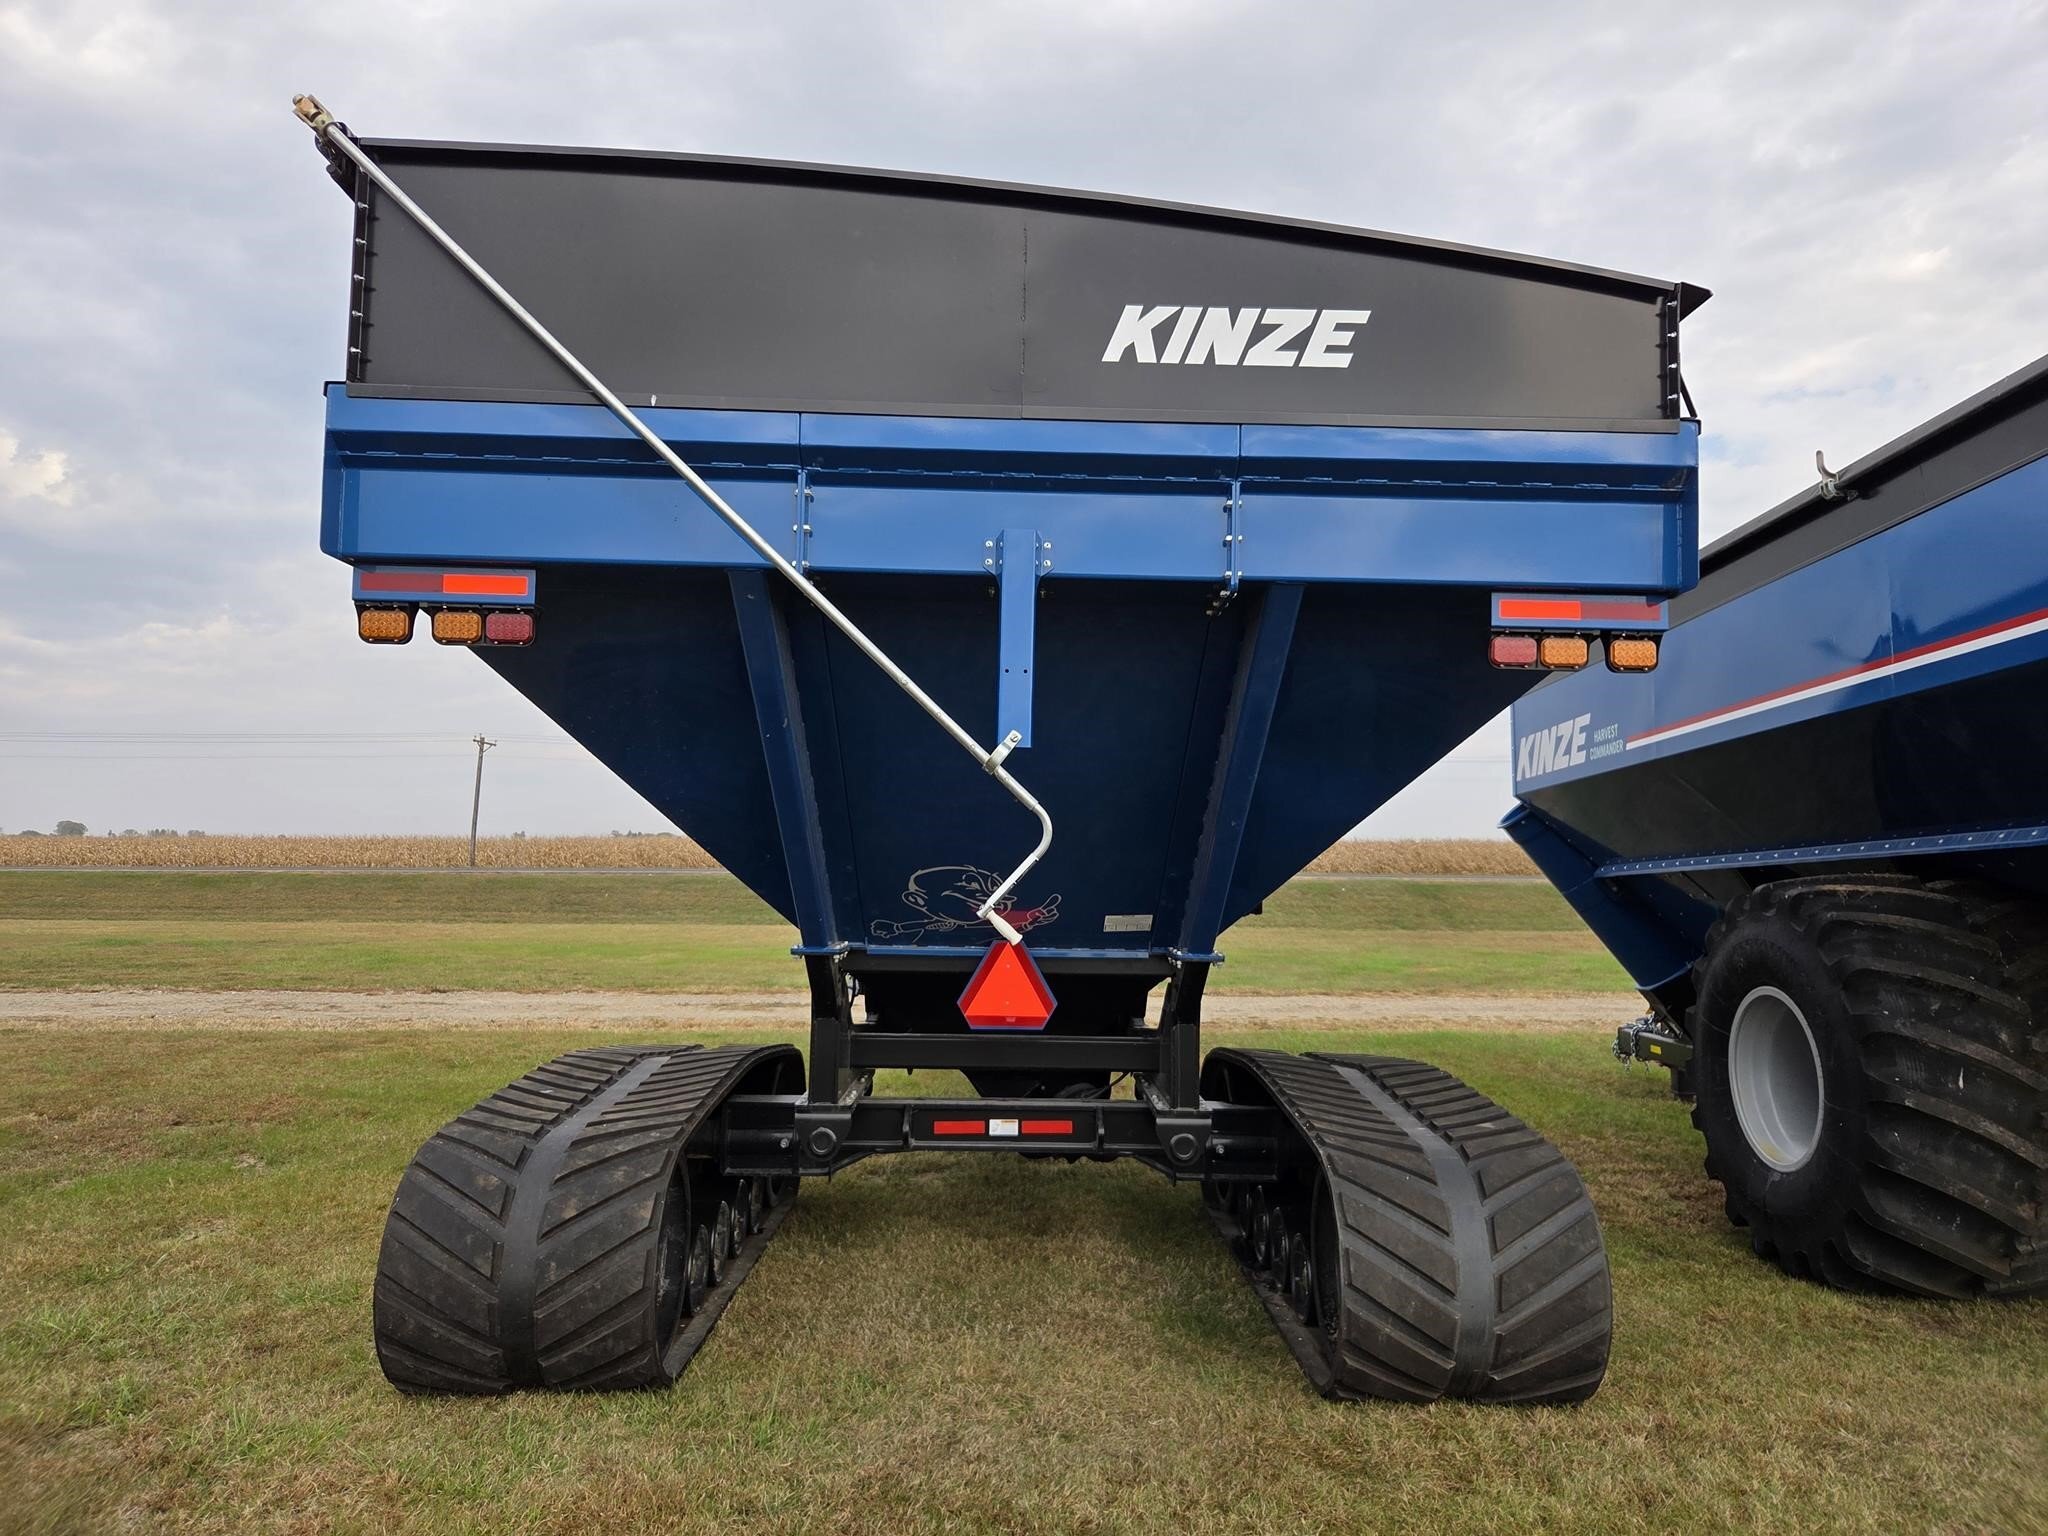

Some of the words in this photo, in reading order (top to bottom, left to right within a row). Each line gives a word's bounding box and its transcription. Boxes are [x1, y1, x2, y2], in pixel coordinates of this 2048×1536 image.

[1101, 304, 1372, 368] KINZE
[1516, 712, 1591, 782] KINZE
[1589, 739, 1624, 760] COMMANDER
[1593, 723, 1619, 743] HARVEST
